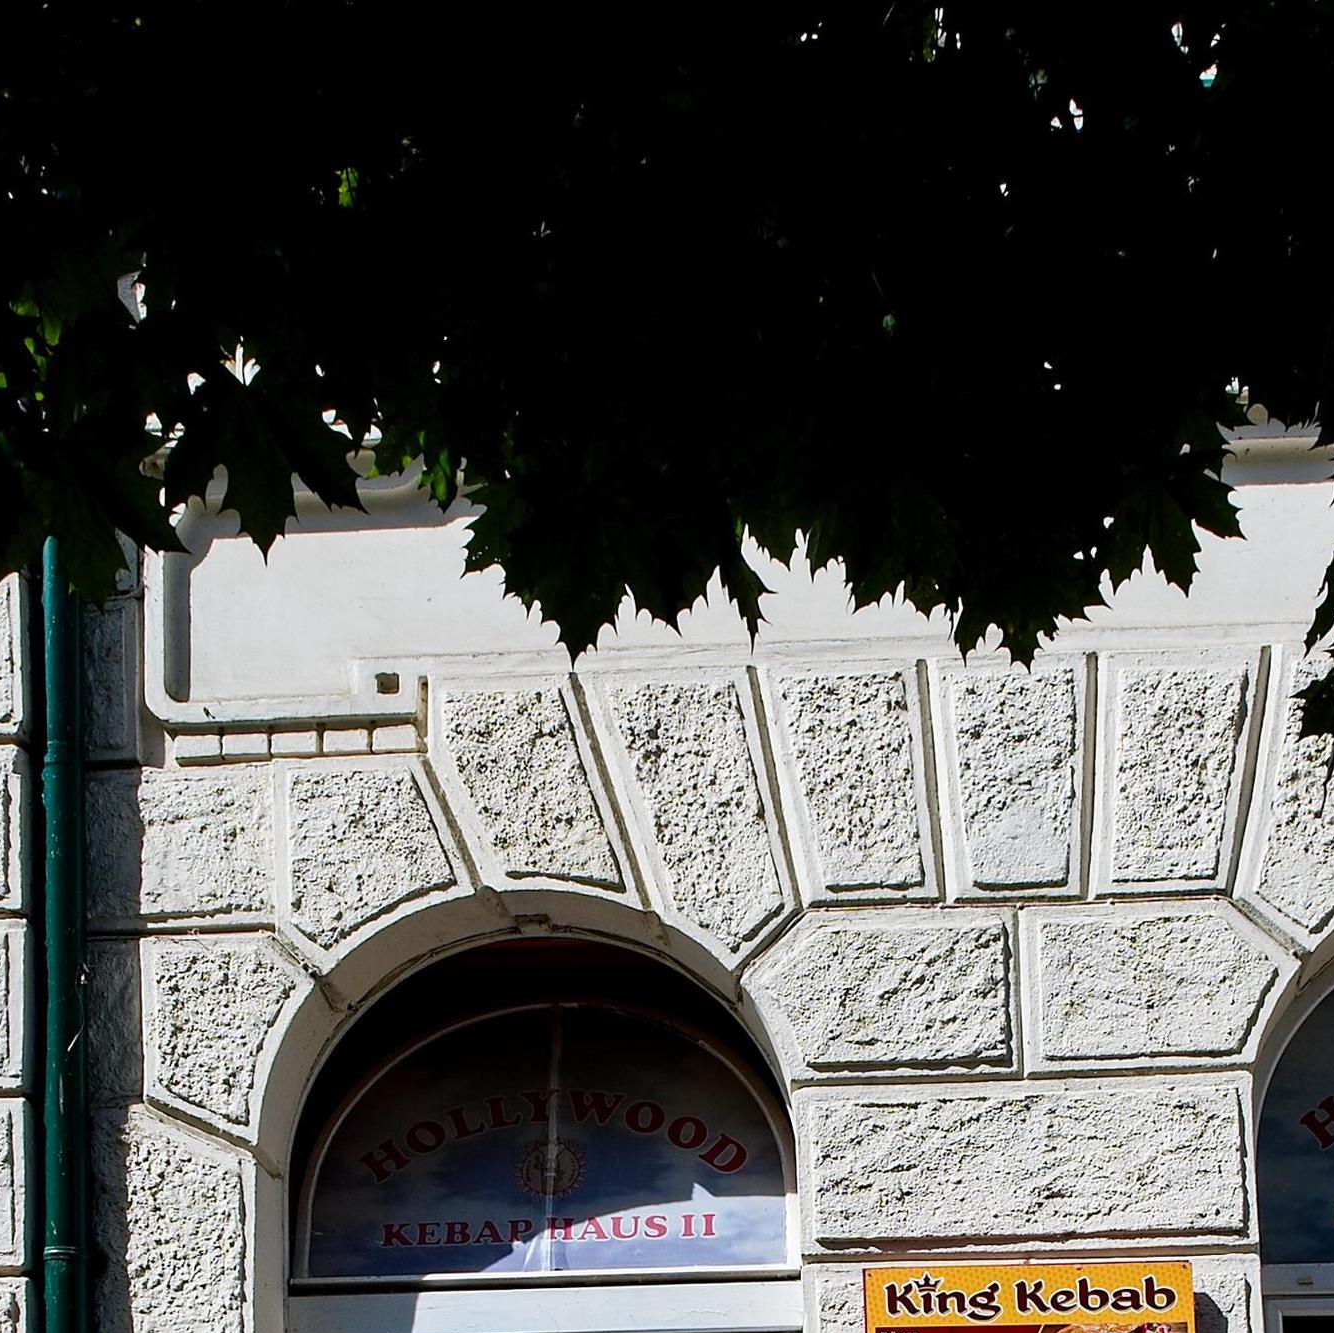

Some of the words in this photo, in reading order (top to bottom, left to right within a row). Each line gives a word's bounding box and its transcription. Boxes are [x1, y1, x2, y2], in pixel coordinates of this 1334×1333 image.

[359, 1089, 749, 1185] HOLLYWOOD
[381, 1219, 534, 1248] KEBAP
[544, 1215, 667, 1242] HAUS
[680, 1213, 717, 1237] II
[884, 1274, 1001, 1320] King
[1015, 1276, 1175, 1312] Kebab
